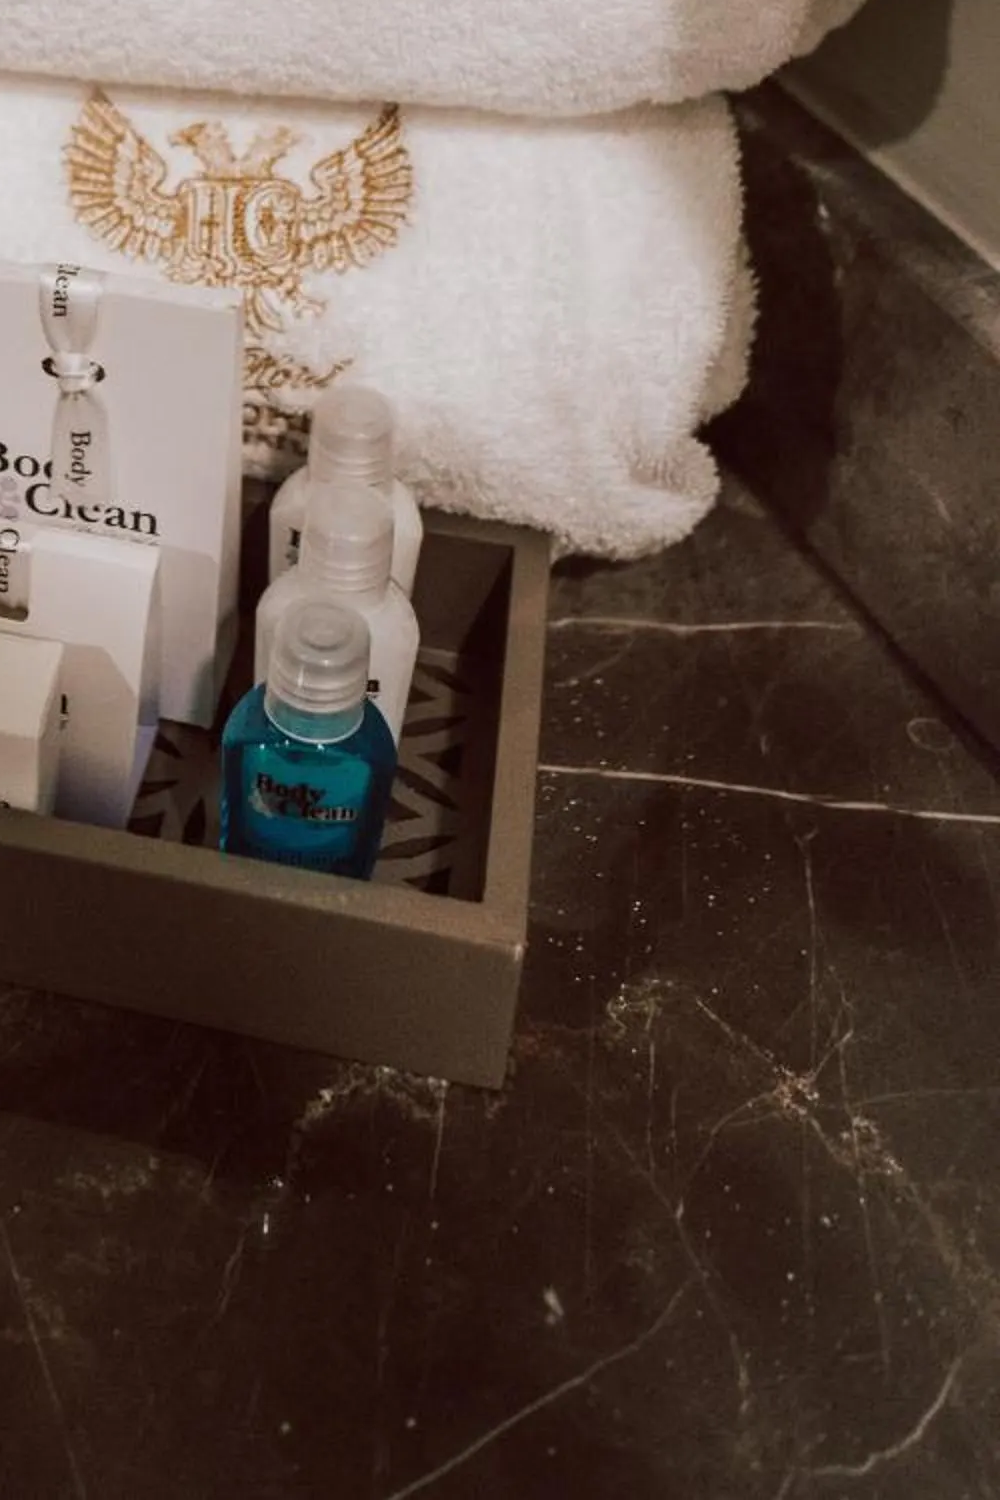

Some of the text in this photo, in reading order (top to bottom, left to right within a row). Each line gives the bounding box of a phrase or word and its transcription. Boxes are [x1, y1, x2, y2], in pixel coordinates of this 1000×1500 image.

[53, 263, 81, 317] lean
[64, 431, 93, 487] Body
[256, 771, 326, 804] Body
